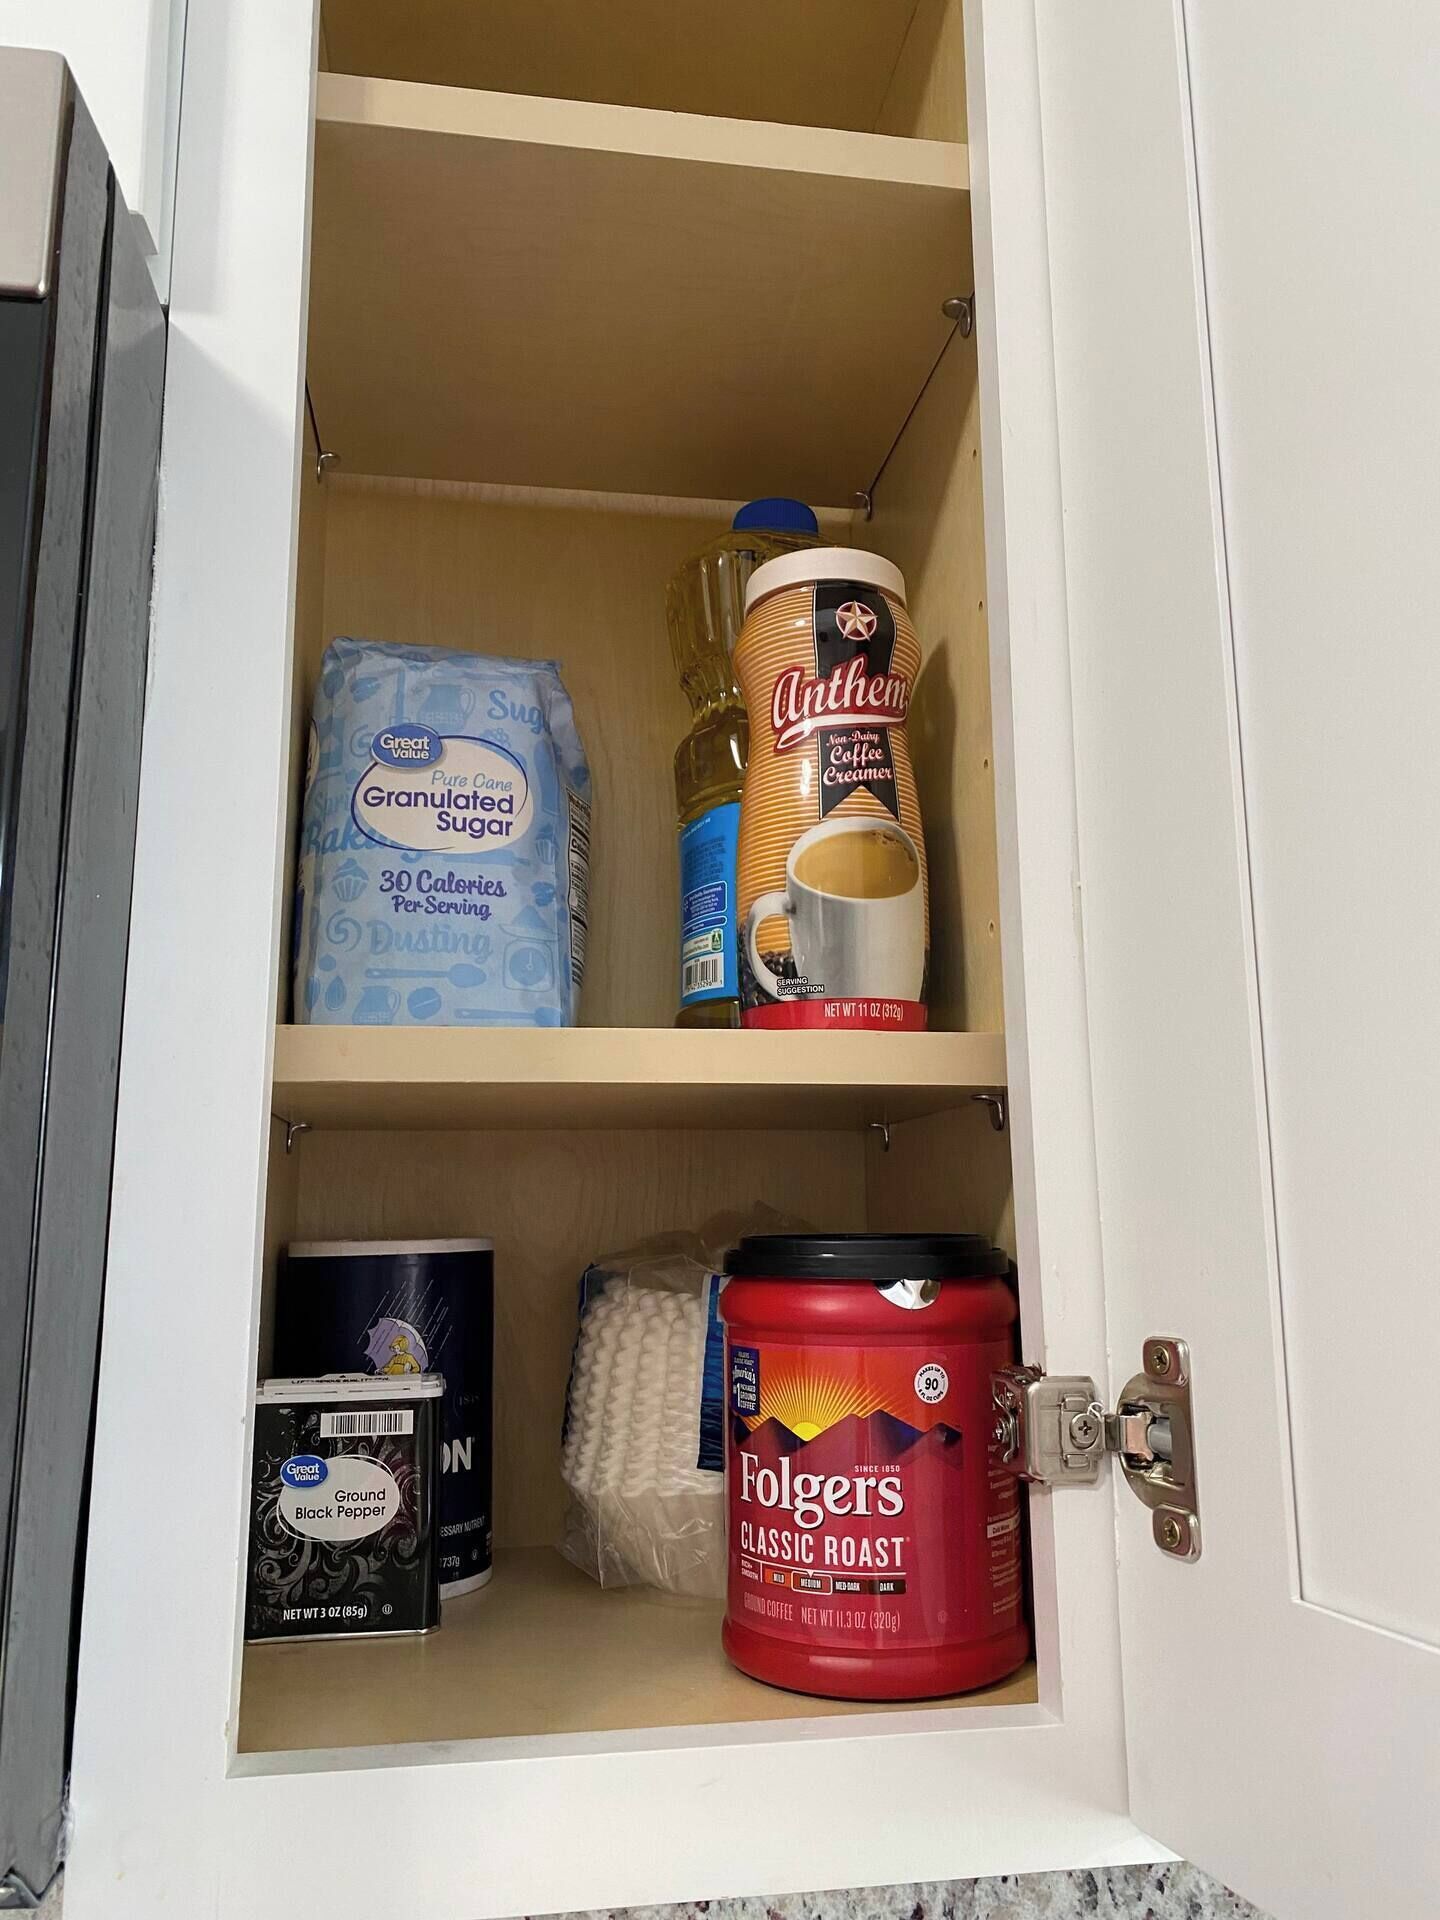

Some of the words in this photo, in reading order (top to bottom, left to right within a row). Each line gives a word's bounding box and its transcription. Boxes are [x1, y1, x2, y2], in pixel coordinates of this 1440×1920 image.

[773, 655, 908, 729] Anthem
[380, 734, 430, 750] Great
[826, 731, 879, 747] Non-Dairy
[392, 748, 429, 760] Value
[830, 743, 884, 767] Coffee
[431, 770, 468, 787] Pure
[473, 773, 513, 792] Cane
[823, 766, 893, 785] Creamer
[363, 786, 514, 815] Granulated
[436, 810, 513, 839] Sugar
[379, 869, 412, 893] 30
[416, 869, 507, 898] Calories
[391, 895, 424, 913] Per
[424, 895, 492, 921] Serving
[365, 919, 494, 965] Dusting
[777, 976, 808, 986] SERVING
[777, 985, 825, 996] SUGGESTION
[824, 1003, 840, 1017] NET
[842, 1003, 856, 1017] WT
[858, 1003, 868, 1017] 11
[870, 1003, 881, 1017] OZ
[882, 1003, 904, 1021] (312g)
[925, 1377, 938, 1390] 90
[286, 1463, 320, 1475] Great
[294, 1472, 320, 1481] Value
[854, 1465, 879, 1473] SINCE
[881, 1465, 900, 1473] 1850
[334, 1488, 386, 1502] Ground
[740, 1451, 904, 1529] Folgers
[295, 1506, 332, 1519] Black
[337, 1506, 386, 1520] Pepper
[741, 1520, 814, 1564] CLASSIC
[824, 1536, 904, 1568] ROAST
[800, 1577, 821, 1588] MEDIUM
[879, 1582, 895, 1592] DARK
[283, 1608, 302, 1620] NET
[303, 1607, 318, 1619] WT
[320, 1607, 326, 1618] 3
[328, 1606, 341, 1618] OZ
[342, 1604, 368, 1619] (85g)
[767, 1600, 793, 1621] COFFEE
[801, 1606, 817, 1625] NET
[820, 1608, 833, 1627] WT
[836, 1610, 852, 1628] 11.3
[854, 1611, 866, 1628] OZ
[869, 1610, 900, 1633] (320g)
